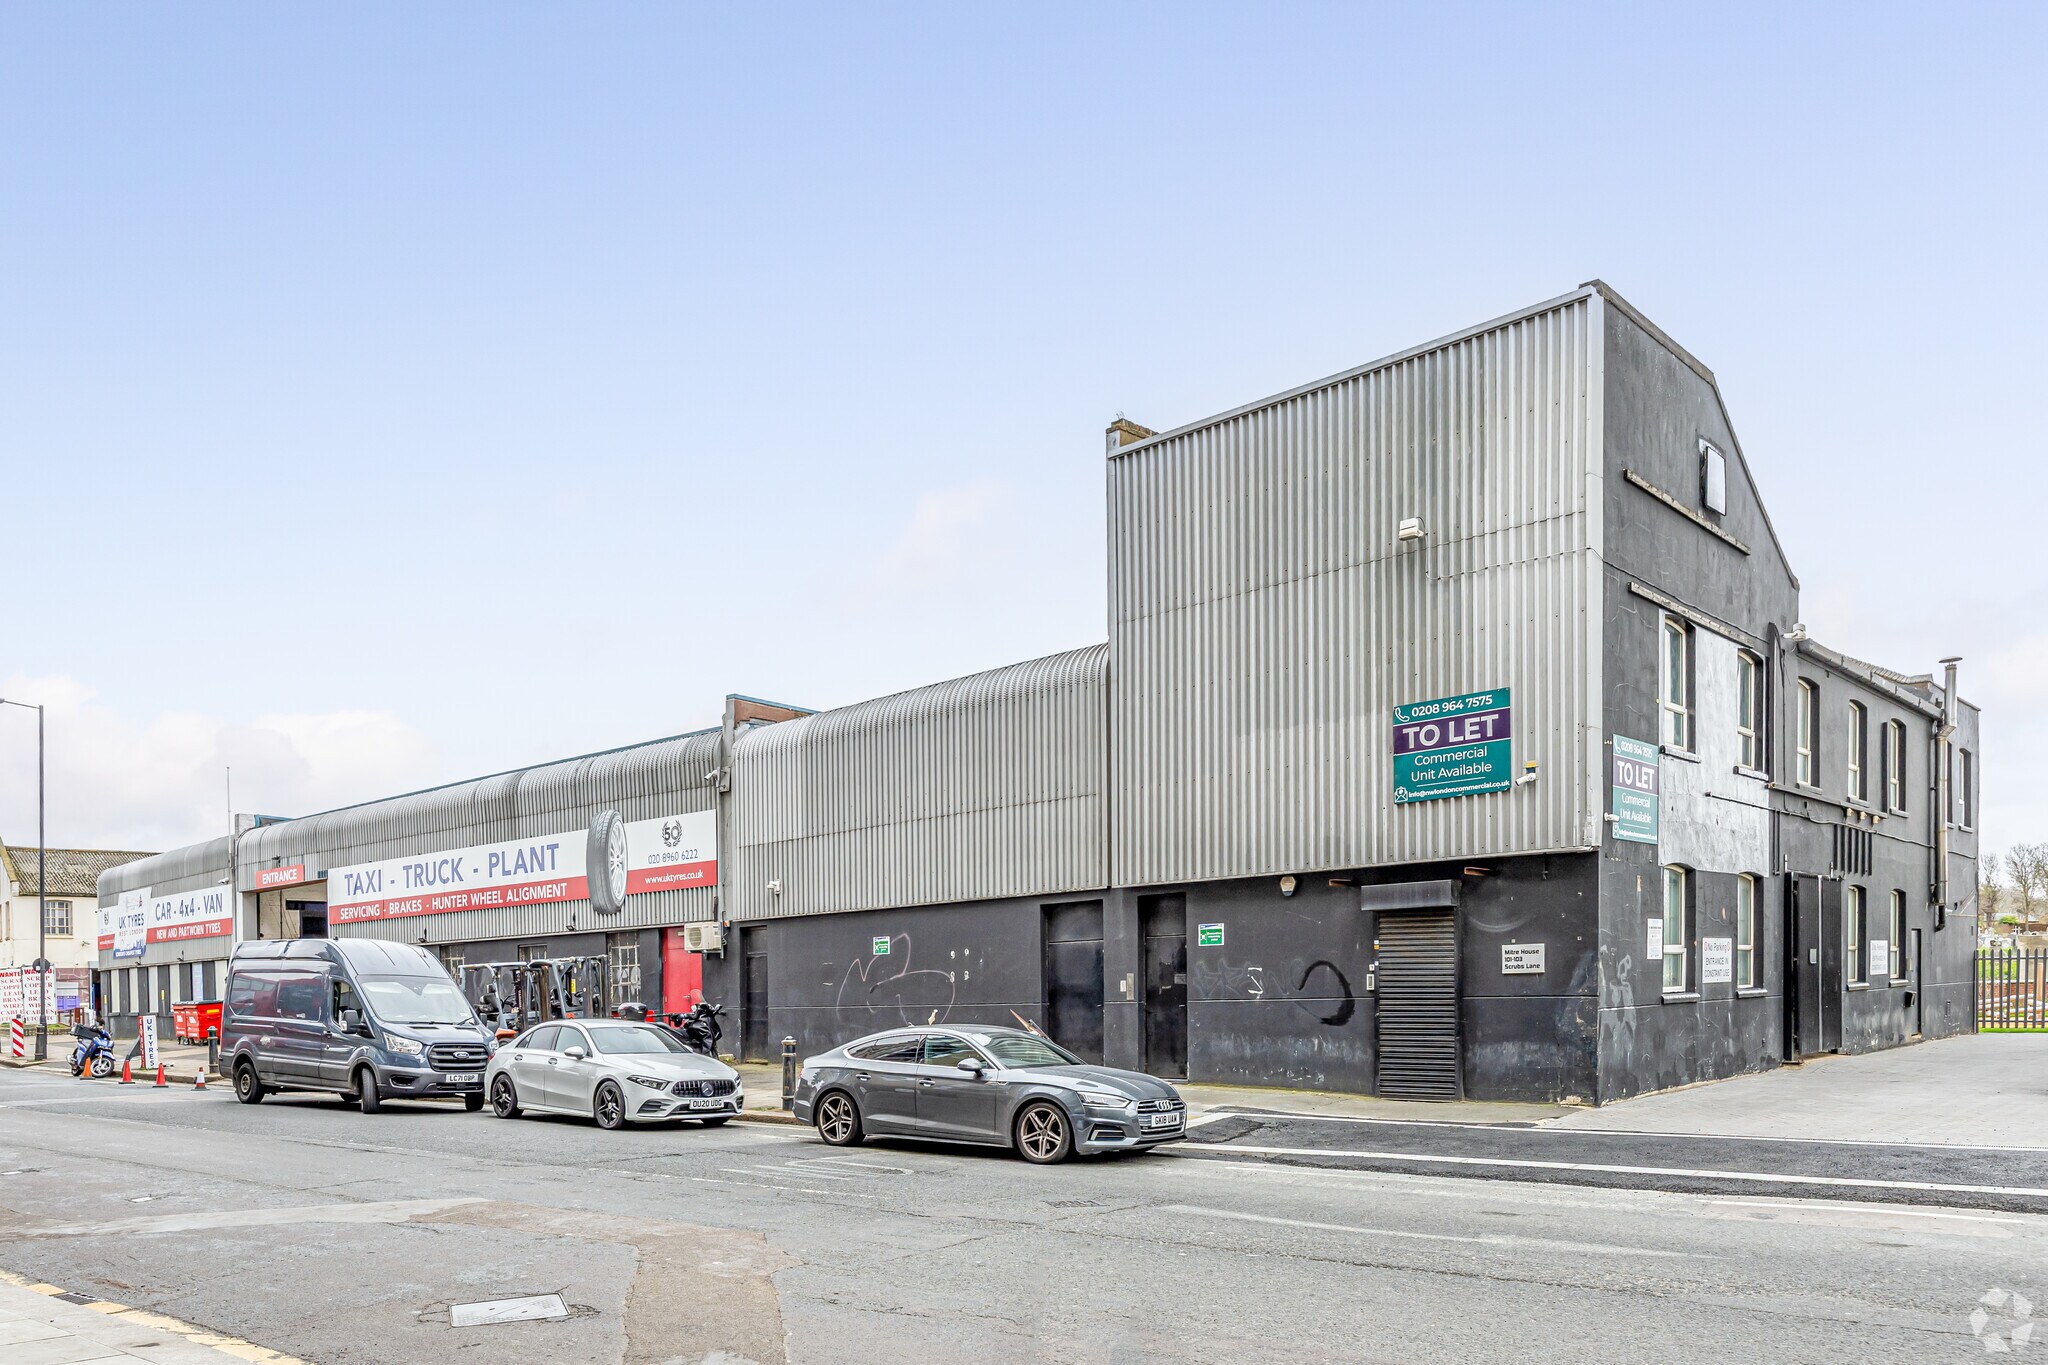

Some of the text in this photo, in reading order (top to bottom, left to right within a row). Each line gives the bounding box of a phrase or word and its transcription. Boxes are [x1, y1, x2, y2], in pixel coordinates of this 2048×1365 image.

[1411, 694, 1493, 717] 0208 964 7575
[1402, 714, 1499, 749] TO LET
[1414, 746, 1488, 766] Commercial
[1620, 741, 1633, 753] 0208
[1411, 761, 1493, 782] Unit Available
[1617, 760, 1655, 790] TO LET
[1408, 779, 1510, 798] info@nwlondoncommercial.co.uk
[1621, 792, 1651, 808] Commercial
[1620, 808, 1632, 820] Unit
[664, 825, 680, 841] 50
[648, 848, 699, 865] 020 8960 6222
[262, 868, 298, 885] ENTRANCE
[344, 869, 382, 896] TAXI
[402, 857, 464, 889] TRUCK
[488, 843, 559, 878] PLANT
[644, 869, 704, 884] www.uktyres.co.uk
[155, 901, 171, 921] CAR
[179, 897, 195, 918] 4x4
[203, 893, 223, 914] VAN
[340, 903, 380, 920] SERVICING
[389, 899, 422, 915] BRAKES
[432, 894, 469, 910] HUNTER
[470, 890, 504, 906] WHEEL
[506, 883, 567, 902] ALIGNMENT
[118, 916, 127, 929] UK
[128, 912, 145, 927] TYRES
[156, 921, 221, 940] NEW AND PARTWORN TYRES
[146, 1018, 153, 1031] UK
[147, 1034, 155, 1067] TYRES
